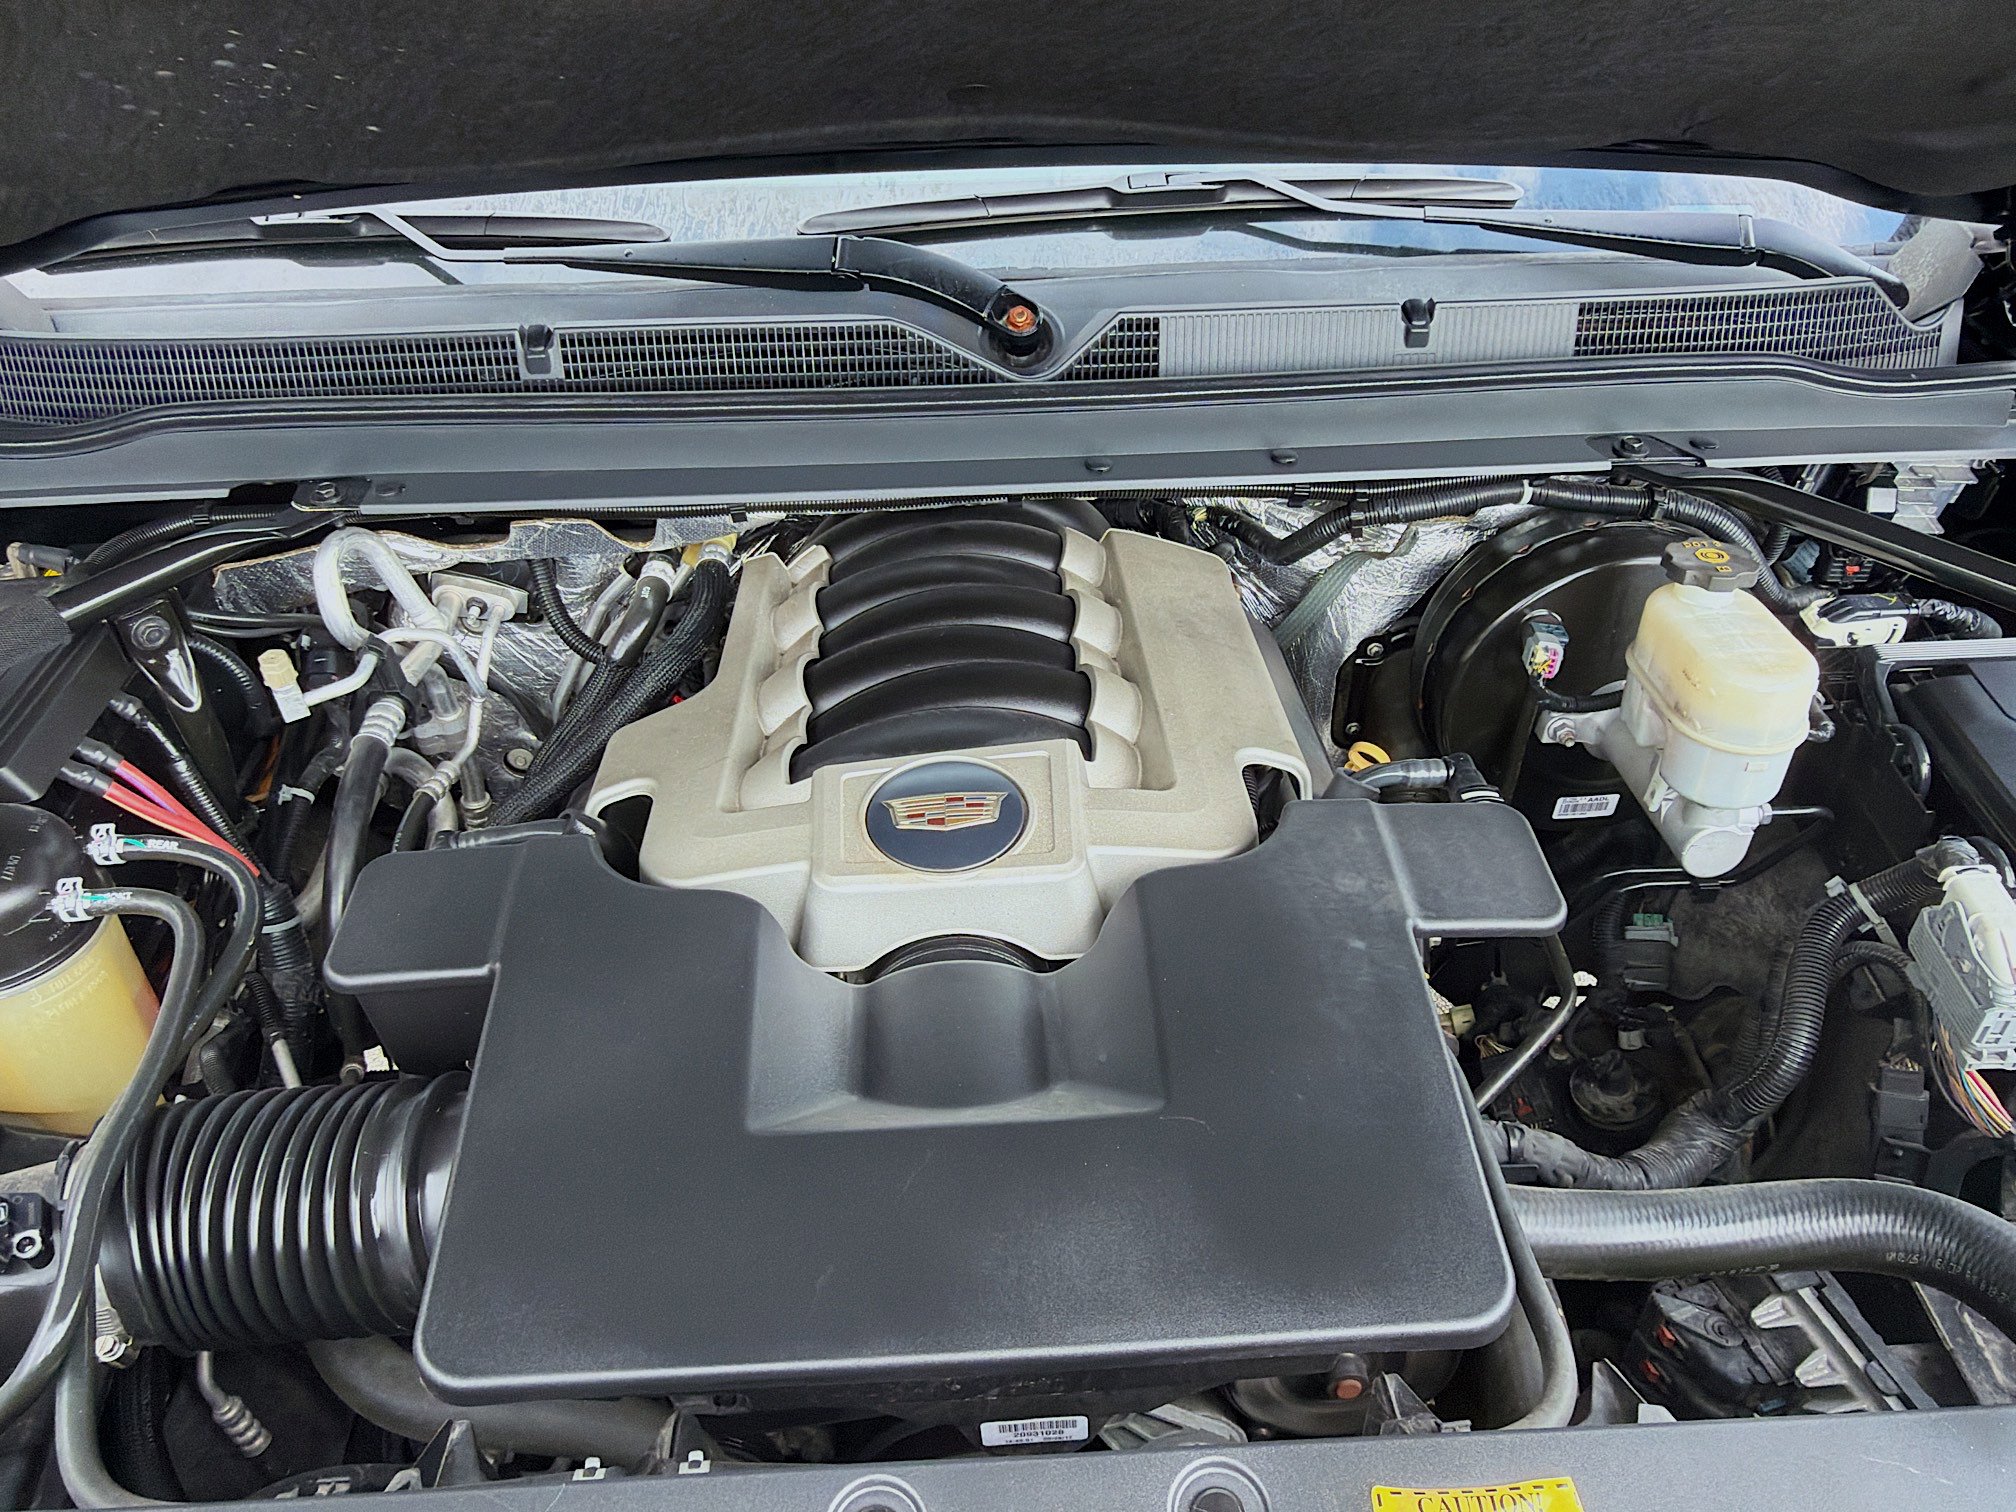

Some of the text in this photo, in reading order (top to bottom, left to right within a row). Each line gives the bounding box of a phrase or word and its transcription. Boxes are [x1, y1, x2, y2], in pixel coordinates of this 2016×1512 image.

[1682, 540, 1708, 549] DOT
[147, 839, 180, 850] REAR
[1416, 1491, 1544, 1512] CAUTION!
